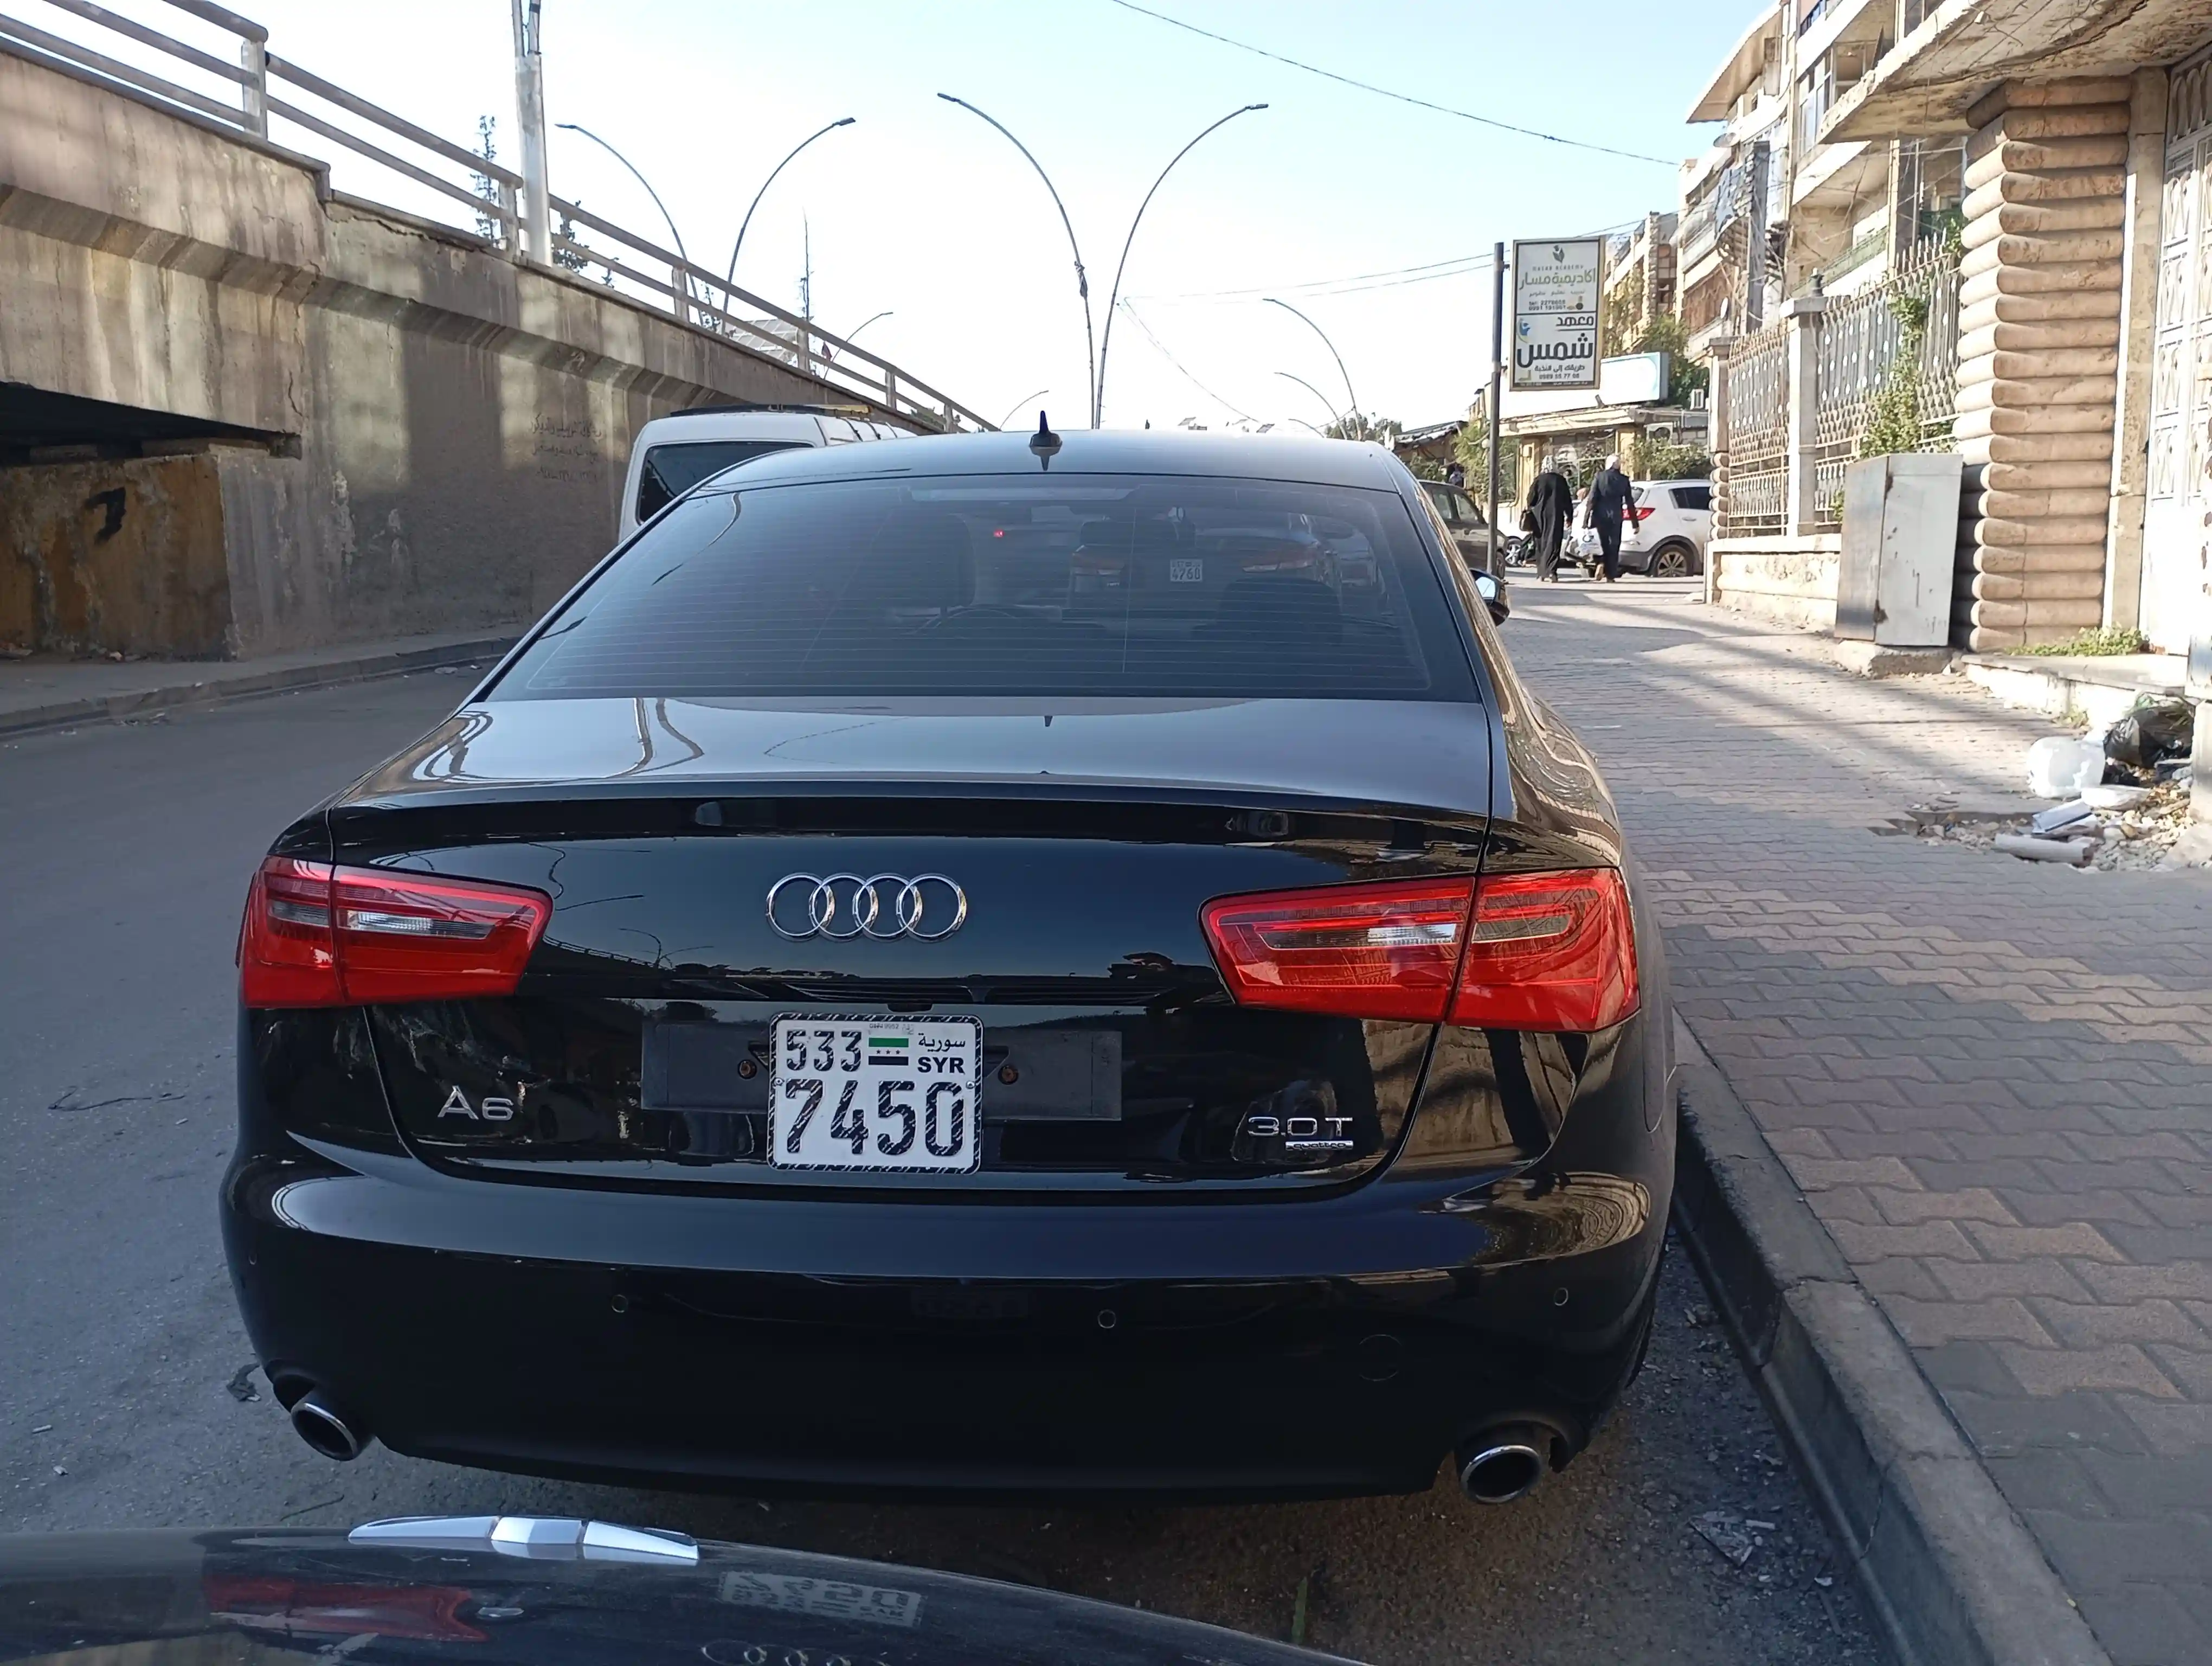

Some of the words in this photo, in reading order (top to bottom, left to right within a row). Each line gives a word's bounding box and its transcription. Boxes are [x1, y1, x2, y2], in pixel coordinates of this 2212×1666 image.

[1519, 272, 1551, 290] مسار
[1556, 316, 1594, 327] معهد
[1517, 332, 1593, 368] شمس
[786, 1030, 862, 1072] 533
[918, 1032, 966, 1053] سورية
[917, 1056, 965, 1074] SYR
[437, 1085, 515, 1121] A6
[785, 1078, 965, 1157] 7450
[1293, 1142, 1347, 1150] quattro
